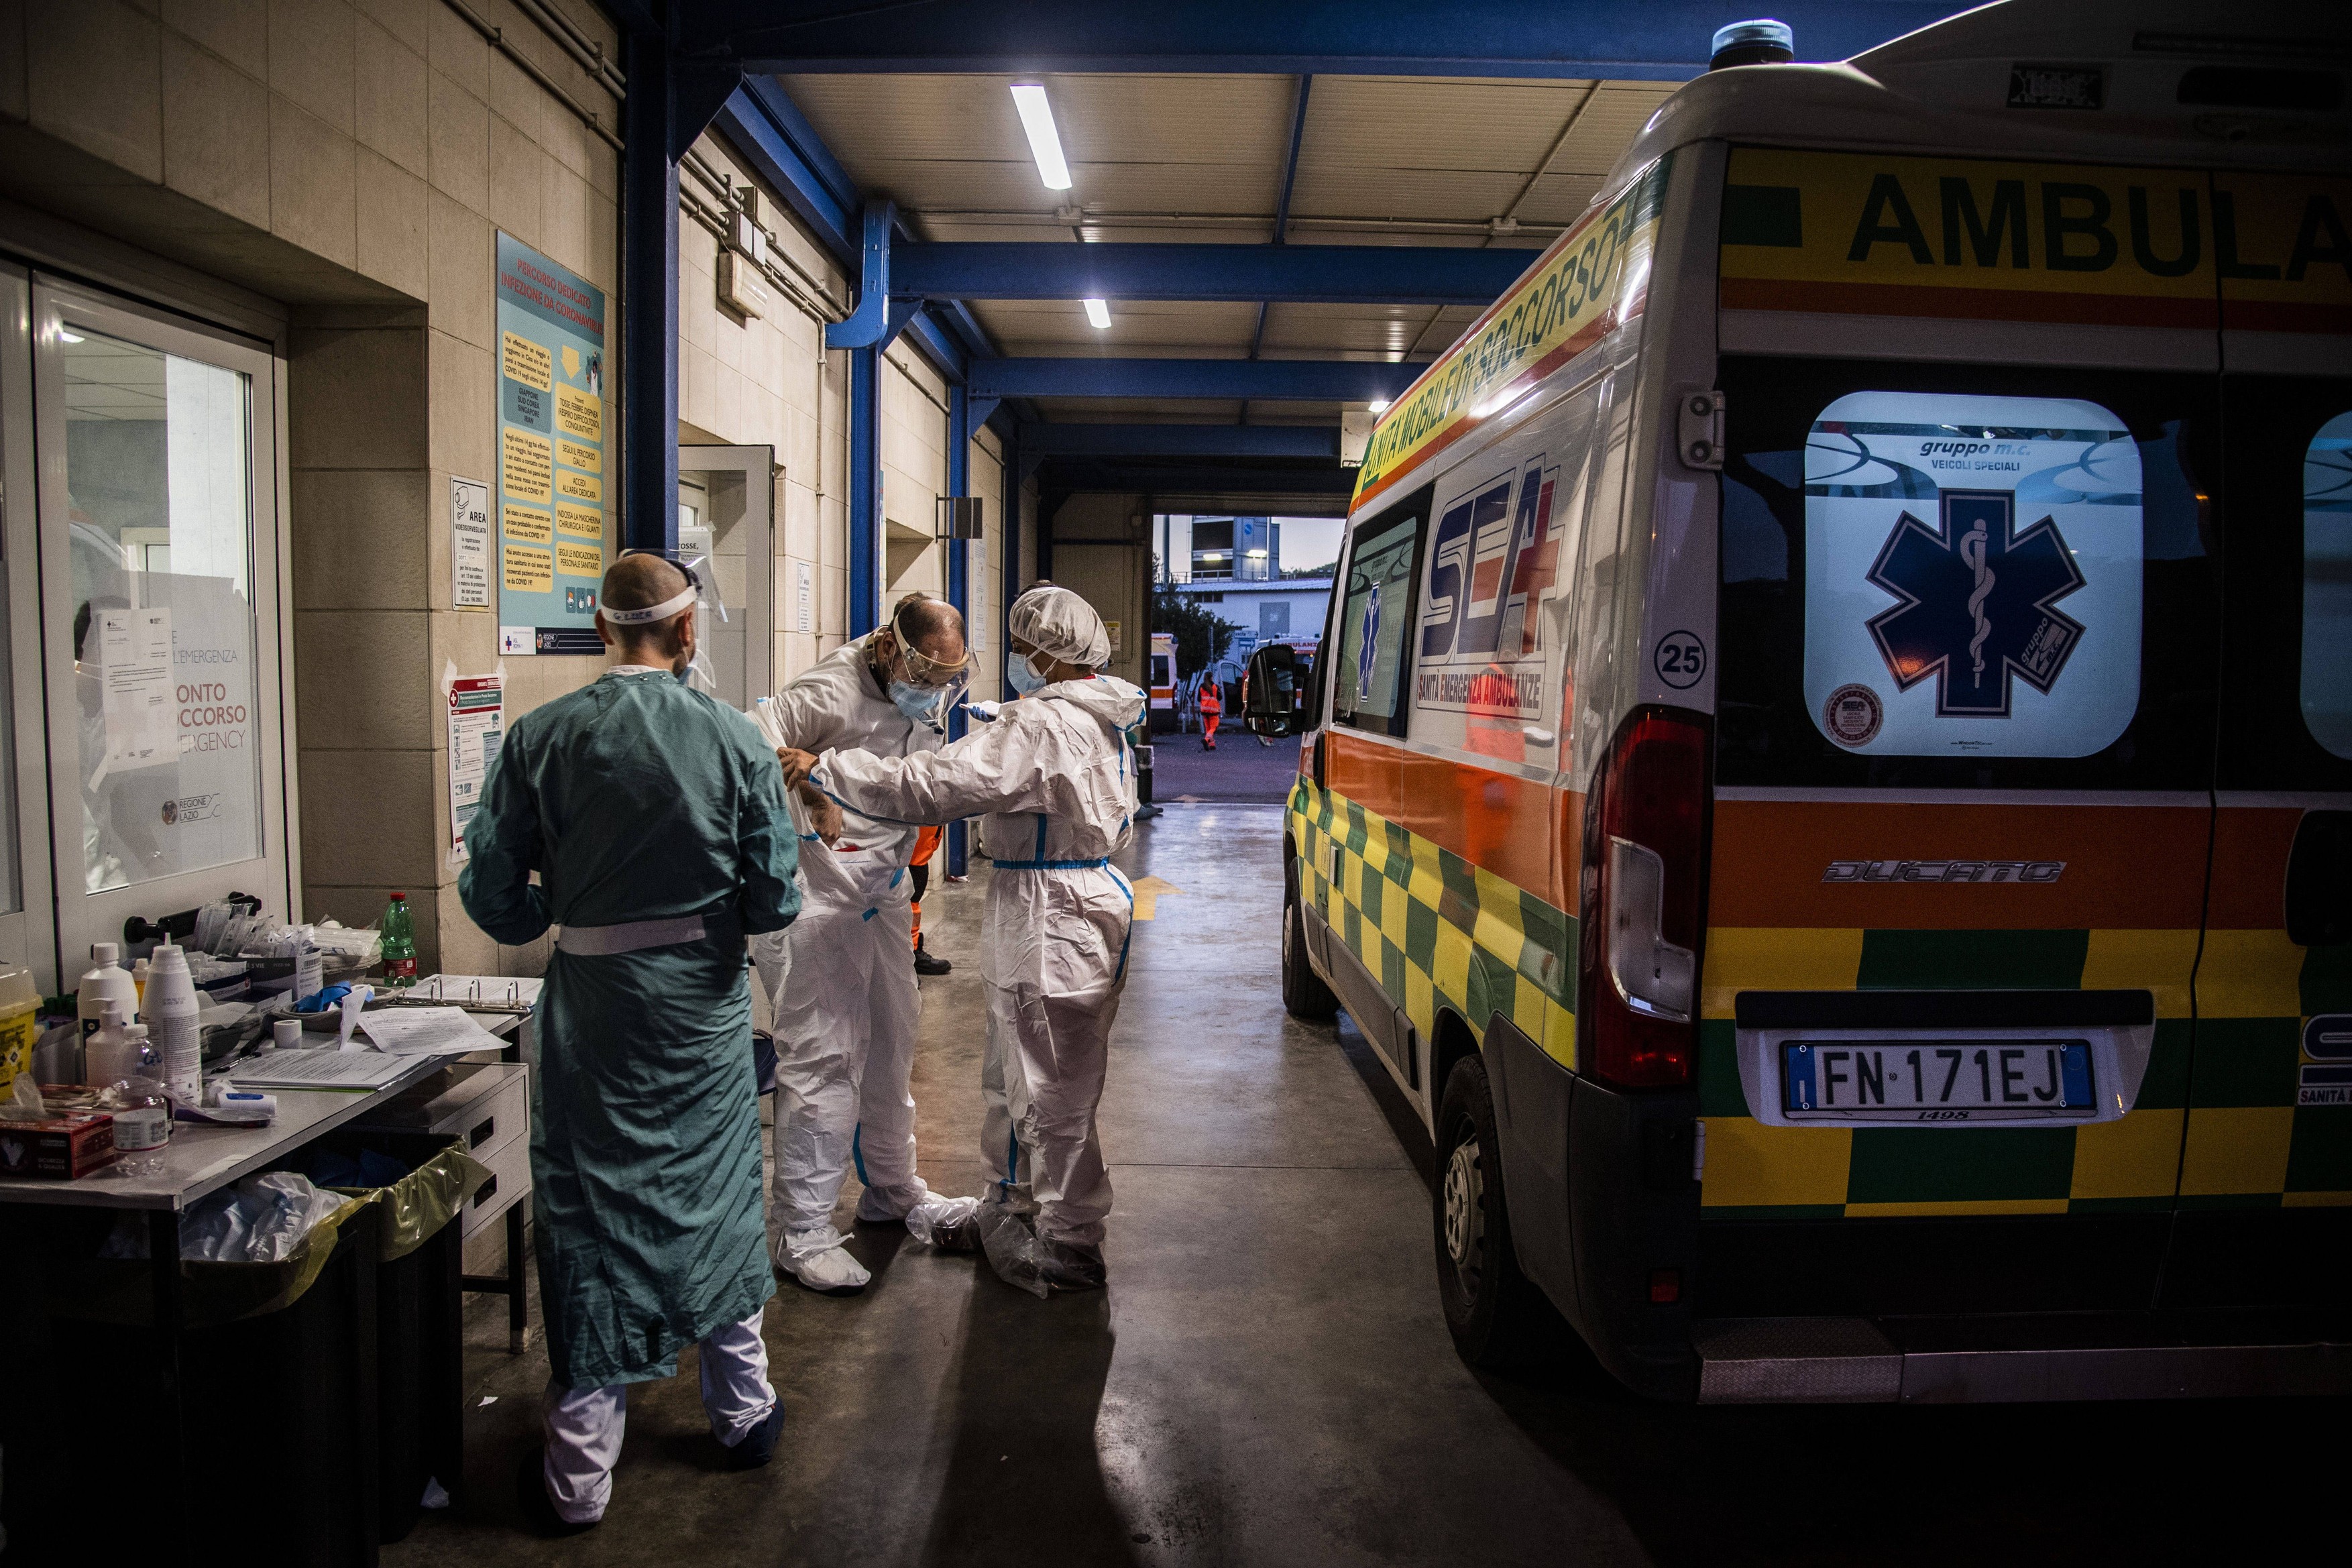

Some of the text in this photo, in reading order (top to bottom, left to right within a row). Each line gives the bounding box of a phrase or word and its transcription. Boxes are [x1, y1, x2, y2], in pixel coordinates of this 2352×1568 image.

[517, 257, 590, 310] PERCORSO DEDICATO
[501, 270, 602, 336] INFEZIONE DA CORONAVIRUS
[1398, 365, 1458, 454] MOBILE
[1451, 349, 1476, 412] DI
[1474, 215, 1619, 394] SOCCORSO
[505, 345, 520, 358] soggiorno
[512, 338, 528, 350] effettuato
[535, 349, 545, 359] viaggio
[505, 355, 545, 376] paesi trasmissione locale
[505, 365, 516, 374] COVID
[530, 375, 538, 383] ultimi
[518, 387, 538, 400] GIAPPONE
[518, 395, 539, 409] SUD COREA
[518, 404, 539, 417] SINGAPORE
[584, 407, 598, 418] DISPNEA
[524, 415, 533, 424] IRAN
[565, 419, 593, 436] CONGIUNTIVITE
[505, 433, 514, 442] Negli
[563, 444, 572, 454] SEGUI
[577, 448, 595, 461] PERCORSO
[1920, 441, 2031, 457] gruppo m.c.
[533, 451, 550, 462] soggiornato
[573, 457, 585, 467] GIALLO
[514, 464, 526, 473] residenti
[1931, 459, 2020, 471] VEICOLI SPECIALI
[572, 477, 585, 487] ACCEDI
[562, 484, 596, 499] ALL'AREA DEDICATA
[469, 511, 486, 523] AREA
[557, 509, 573, 519] INDOSSA
[579, 514, 600, 524] MASCHERINA
[455, 523, 486, 534] VIDEOSORVEGLIATA
[510, 528, 523, 536] infezione
[517, 520, 530, 529] probabile
[534, 523, 550, 531] confermato
[559, 519, 580, 530] CHIRURGICA
[586, 524, 600, 534] GUANTI
[558, 548, 567, 556] SEGUI
[573, 550, 594, 560] INDICAZIONI
[1420, 454, 1563, 663] SEA
[560, 558, 598, 569] PERSONALE SANITARIO
[522, 569, 533, 577] pazienti
[2021, 617, 2048, 665] gruppo
[173, 649, 237, 664] L'EMERGENZA
[1662, 645, 1700, 674] 25
[176, 683, 226, 704] ONTO
[1418, 669, 1541, 709] SANITÀ EMERGENZA AMBULANZE
[1842, 701, 1865, 710] SEA
[177, 705, 246, 728] CCORSO
[177, 729, 246, 754] ERGENCY
[179, 797, 207, 809] REGIONE
[180, 810, 199, 822] LAZIO
[1821, 860, 2068, 883] DUCATO
[1823, 1049, 2058, 1105] FN 171EJ
[1917, 1111, 1970, 1120] 1498
